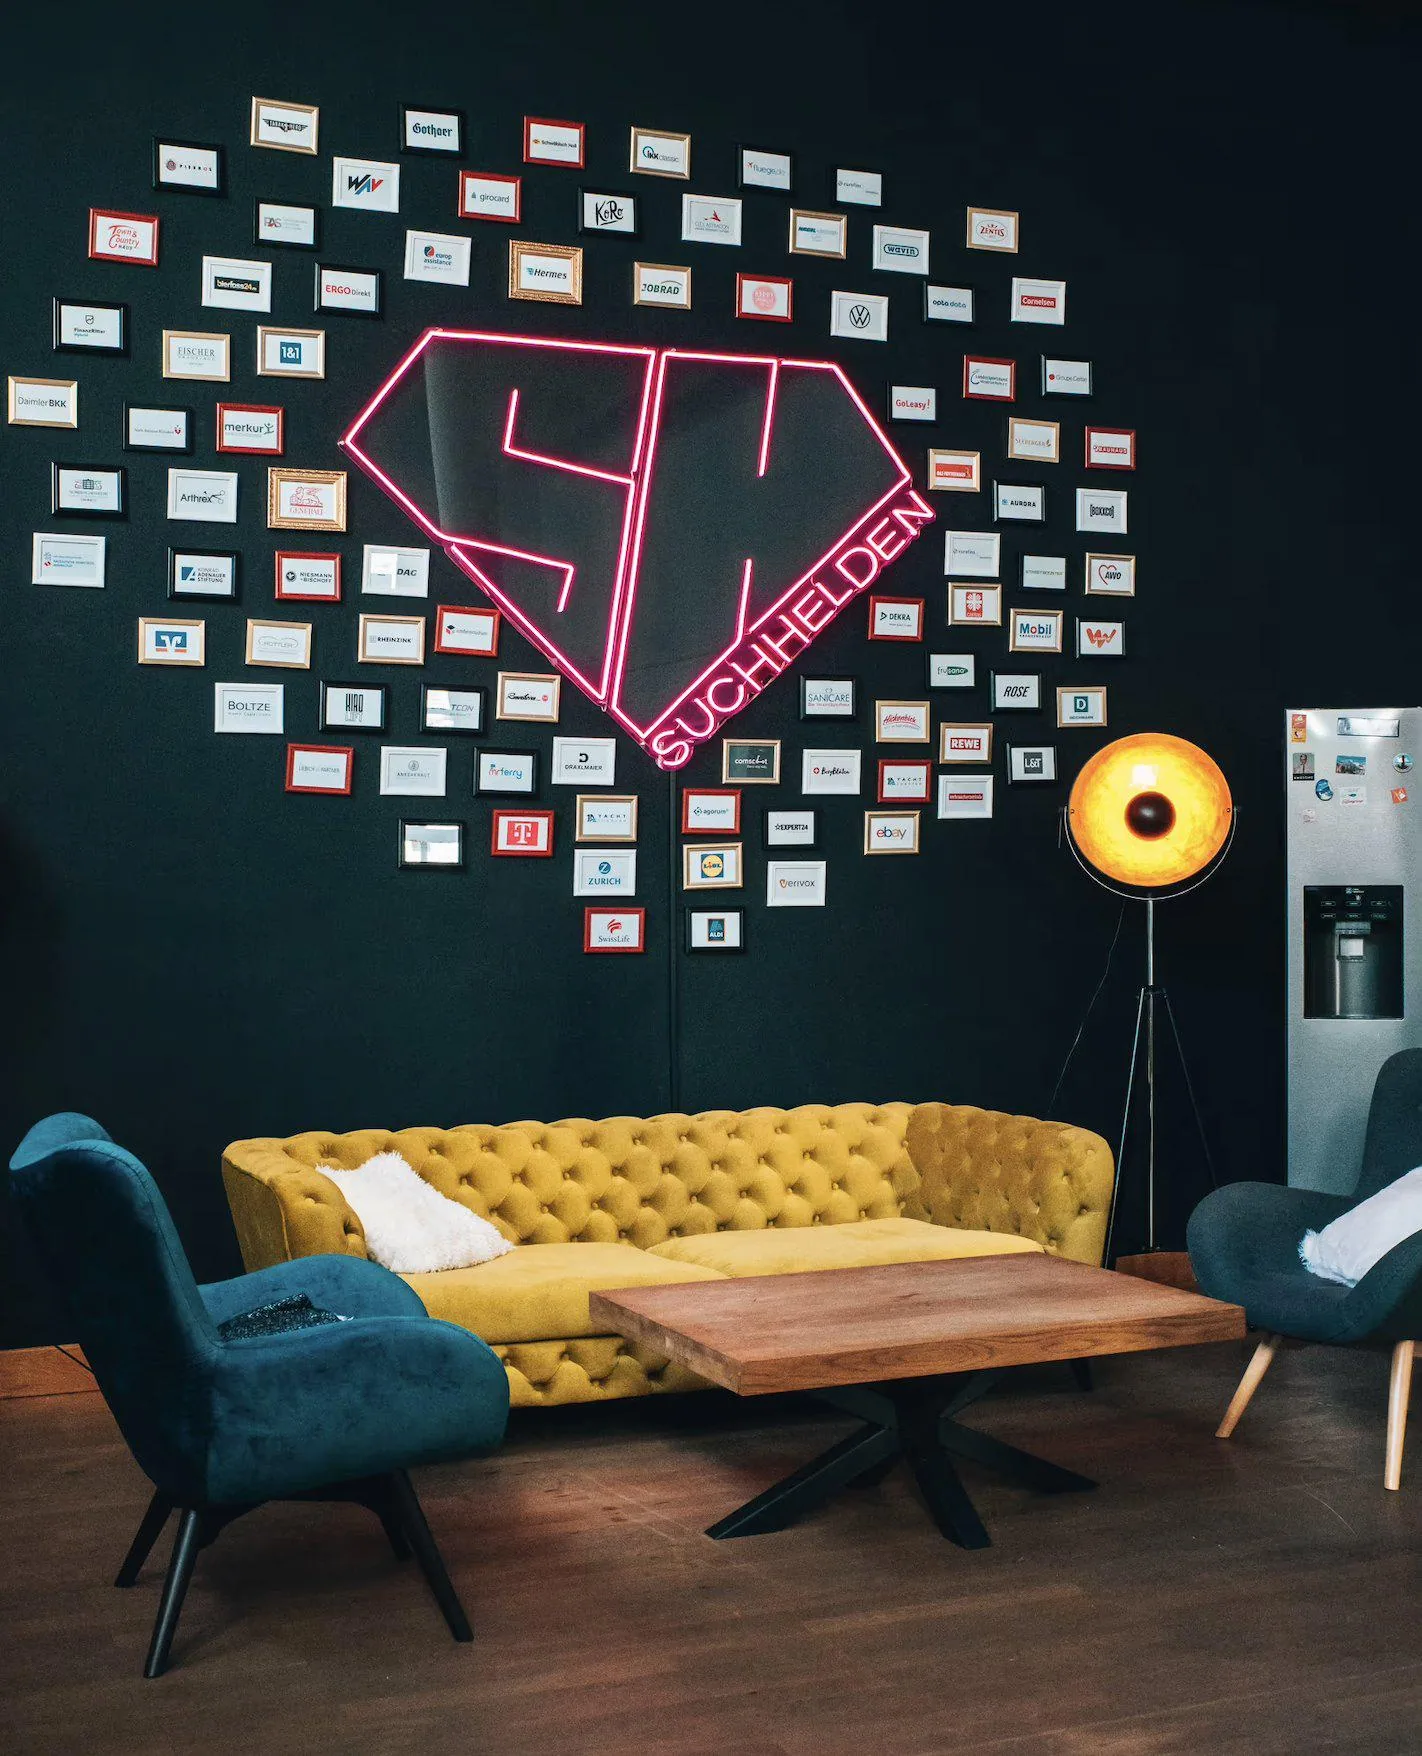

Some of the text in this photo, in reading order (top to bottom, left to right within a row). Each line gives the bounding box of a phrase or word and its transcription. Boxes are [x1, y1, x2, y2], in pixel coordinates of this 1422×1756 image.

[412, 122, 452, 138] Gothaer
[659, 153, 679, 163] classic
[479, 193, 509, 204] girocard
[108, 224, 138, 239] Town &
[980, 225, 1005, 238] ZENTIS
[108, 233, 140, 250] Country
[887, 245, 916, 256] wavin
[423, 257, 453, 267] assistance
[435, 253, 453, 262] europ
[533, 268, 567, 280] Hermes
[325, 284, 372, 297] ERGO Direkt
[641, 283, 681, 296] JOBRAD
[933, 300, 966, 309] opta data
[1021, 296, 1056, 308] Cornelsen
[177, 346, 216, 358] FISCHER
[281, 346, 301, 360] 1&1
[49, 399, 67, 409] BKK
[895, 398, 931, 412] GoLeasy!
[224, 422, 263, 434] merkur
[180, 493, 213, 505] Arthrex
[197, 572, 227, 580] ADENAUER
[1105, 572, 1121, 580] AWO
[889, 613, 911, 621] DEKRA
[651, 489, 935, 769] SUCHHELDEN
[1019, 622, 1052, 636] Mobil
[1003, 685, 1030, 698] ROSE
[345, 693, 364, 713] HIRO
[807, 693, 850, 703] SANICARE
[228, 700, 272, 712] BOLTZE
[951, 737, 981, 750] REWE
[1024, 757, 1043, 769] L&T
[876, 826, 907, 840] ebay
[587, 876, 622, 887] ZURICH
[598, 935, 630, 943] SwissLife
